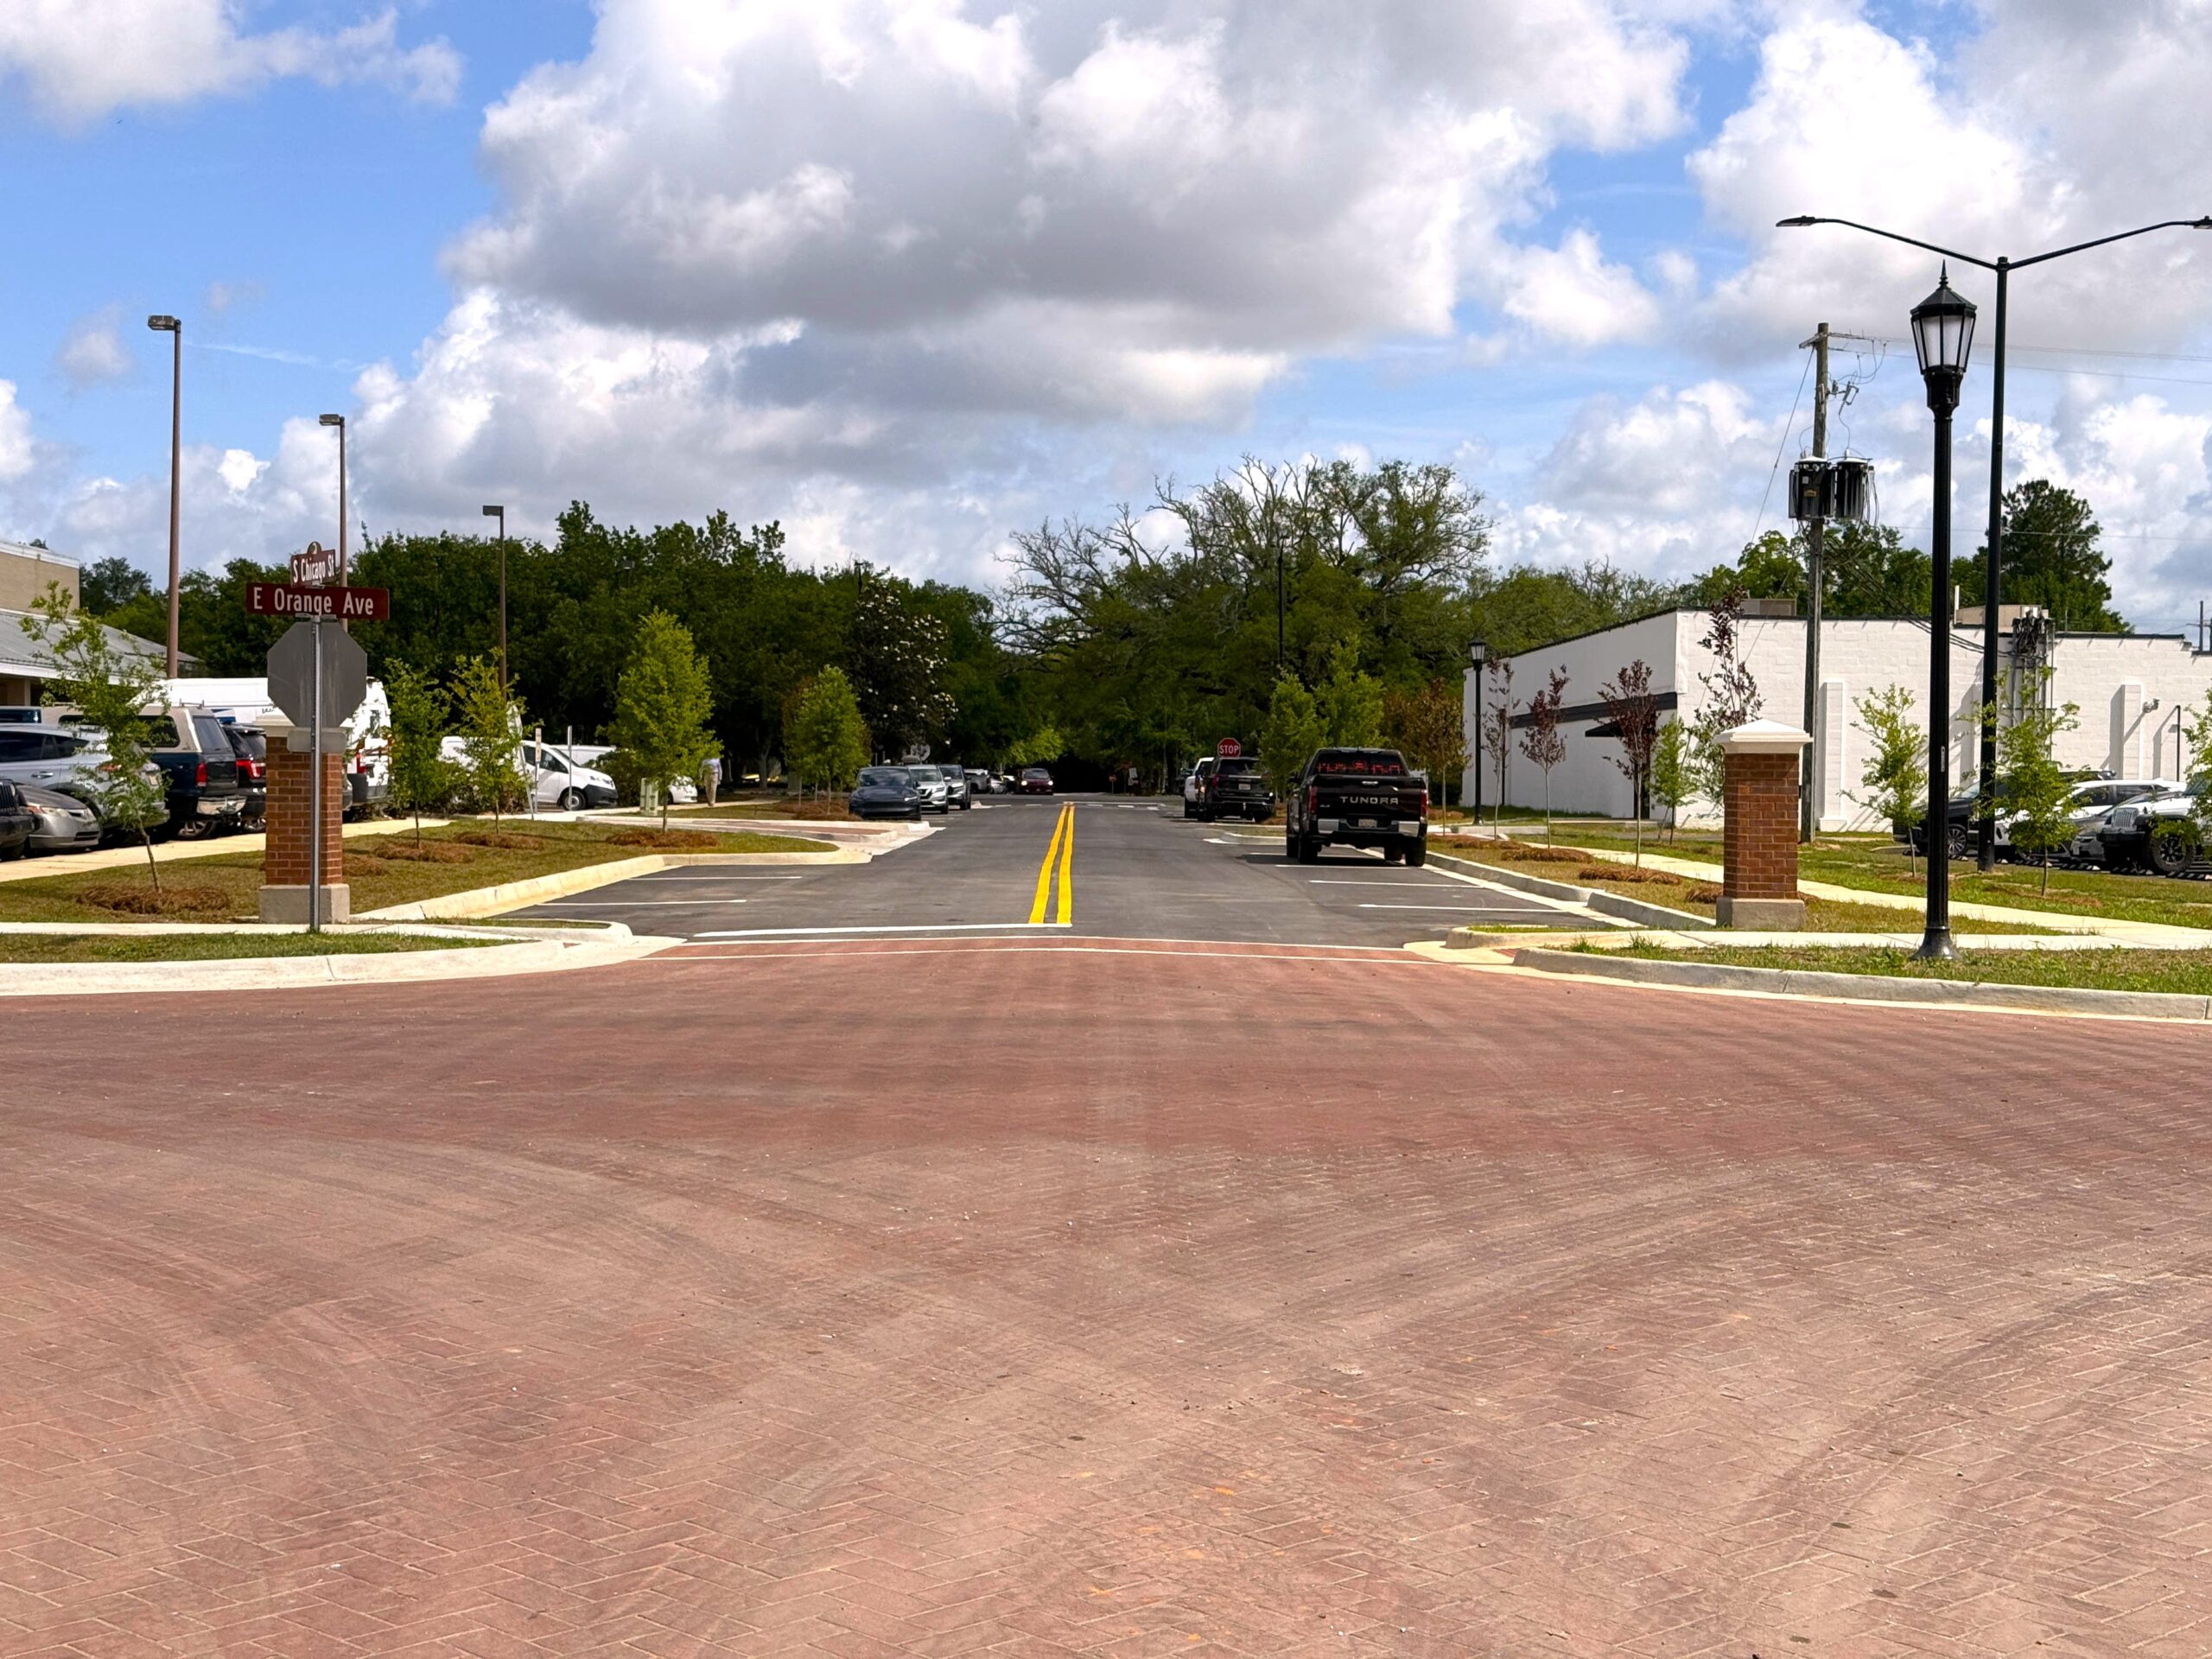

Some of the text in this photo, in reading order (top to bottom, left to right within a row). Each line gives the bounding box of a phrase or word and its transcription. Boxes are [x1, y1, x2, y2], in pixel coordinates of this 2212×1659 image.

[293, 554, 335, 583] S Chicago St
[253, 587, 374, 616] E Orange Ave
[1219, 745, 1239, 754] STOP
[1339, 796, 1399, 804] TUNDRA
